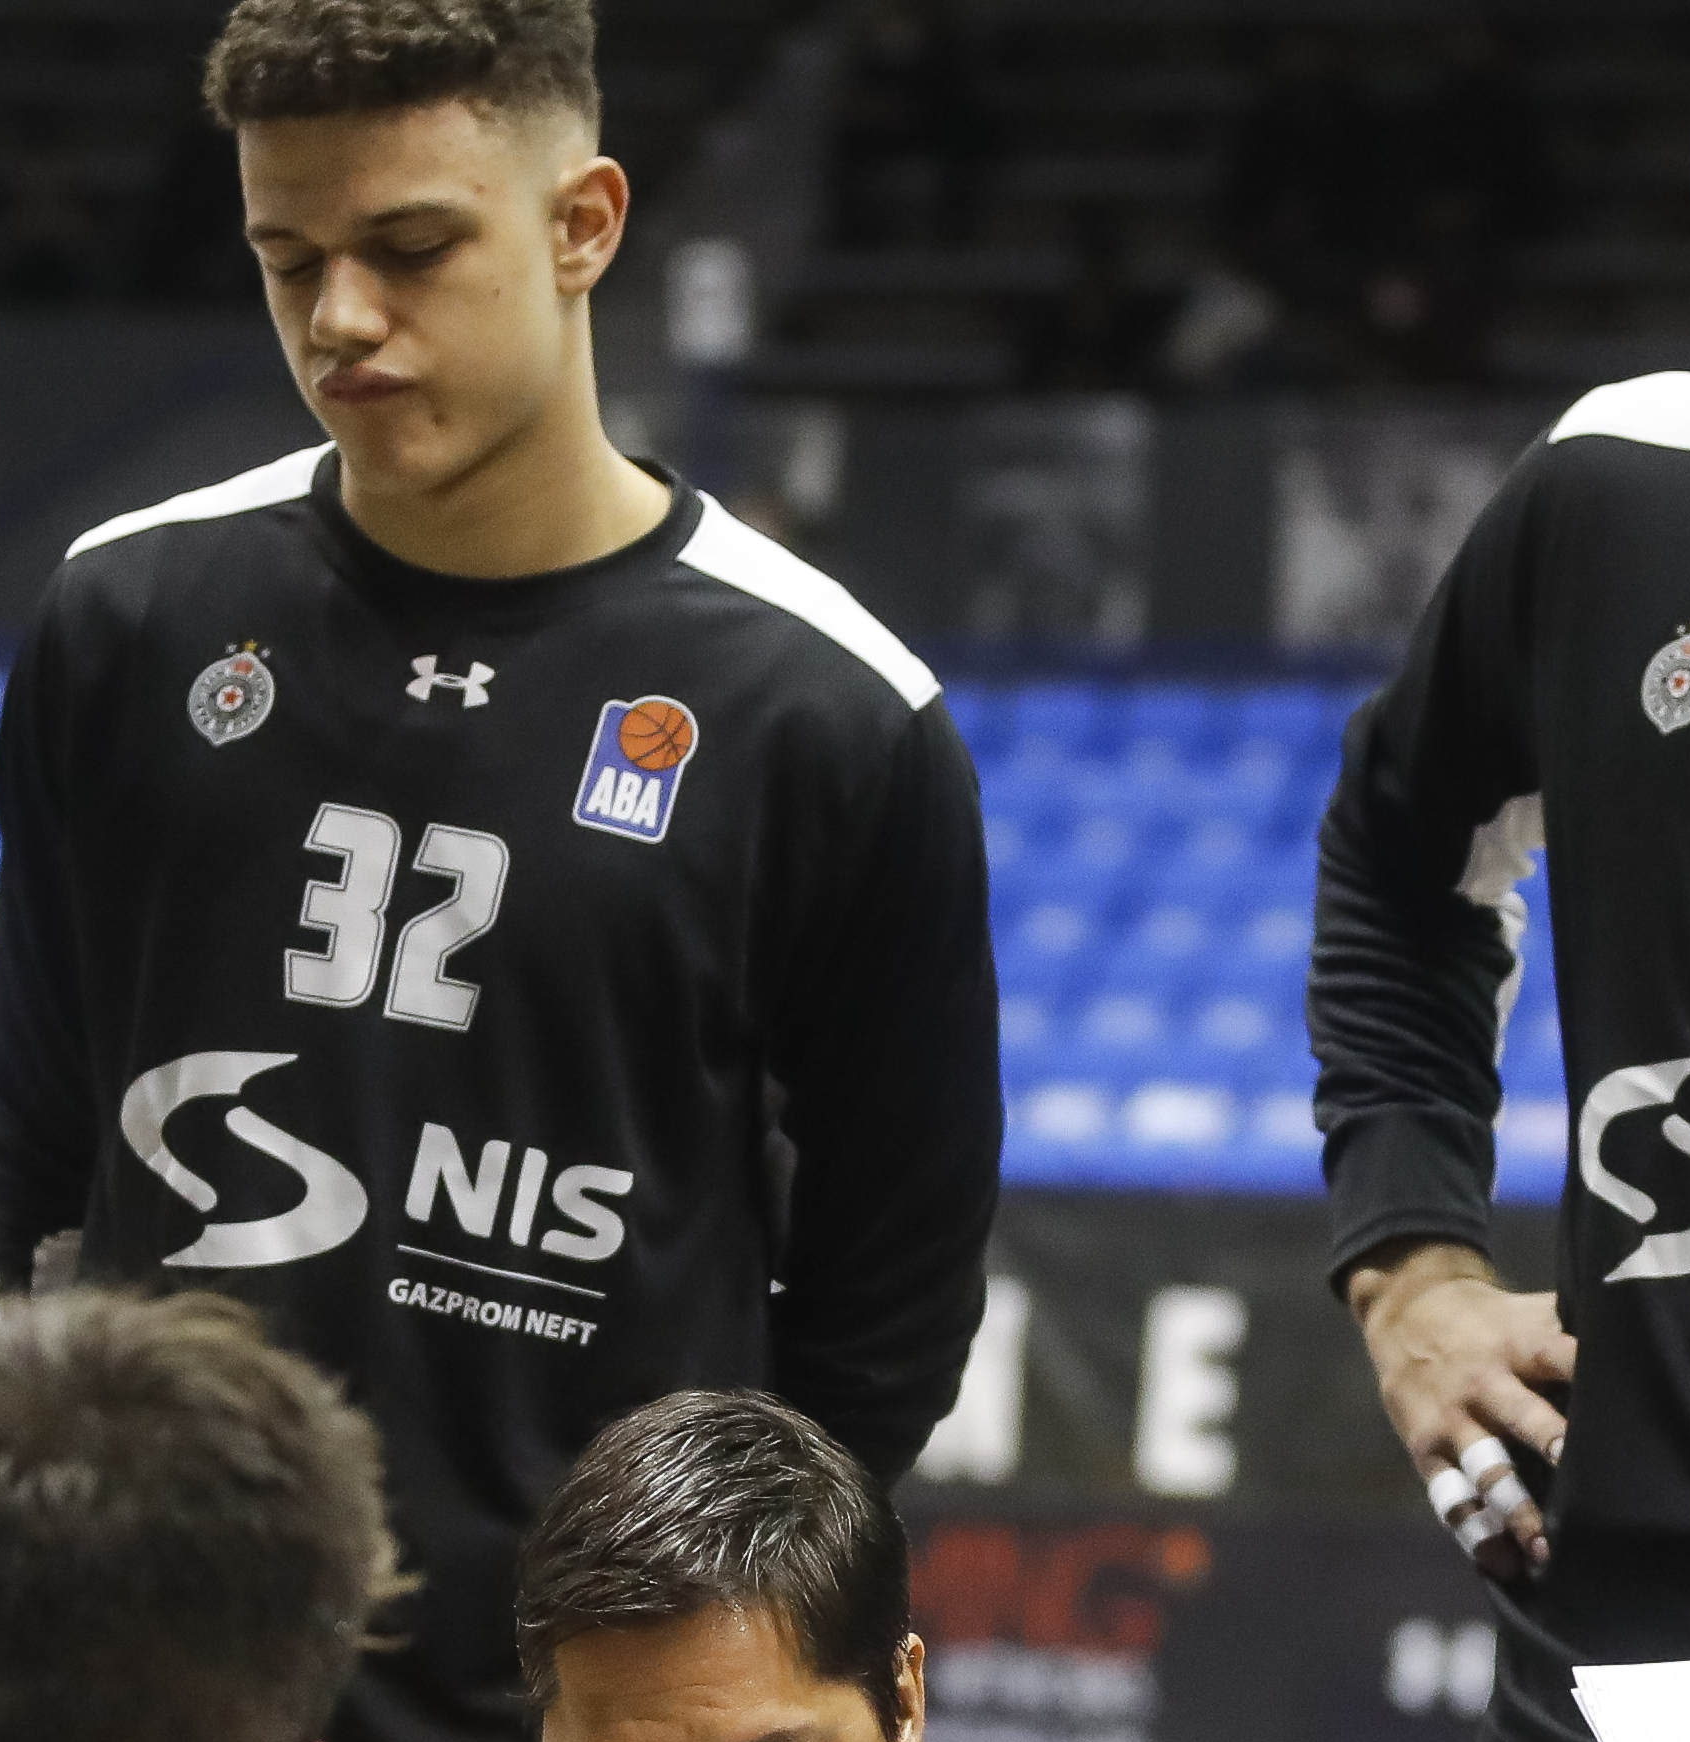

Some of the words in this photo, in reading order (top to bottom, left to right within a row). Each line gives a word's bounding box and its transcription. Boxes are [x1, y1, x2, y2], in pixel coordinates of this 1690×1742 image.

[586, 765, 662, 829] ABA
[283, 802, 509, 1031] 32
[405, 1122, 634, 1262] NIS
[388, 1278, 523, 1331] GAZPROM
[525, 1309, 598, 1347] NEFT
